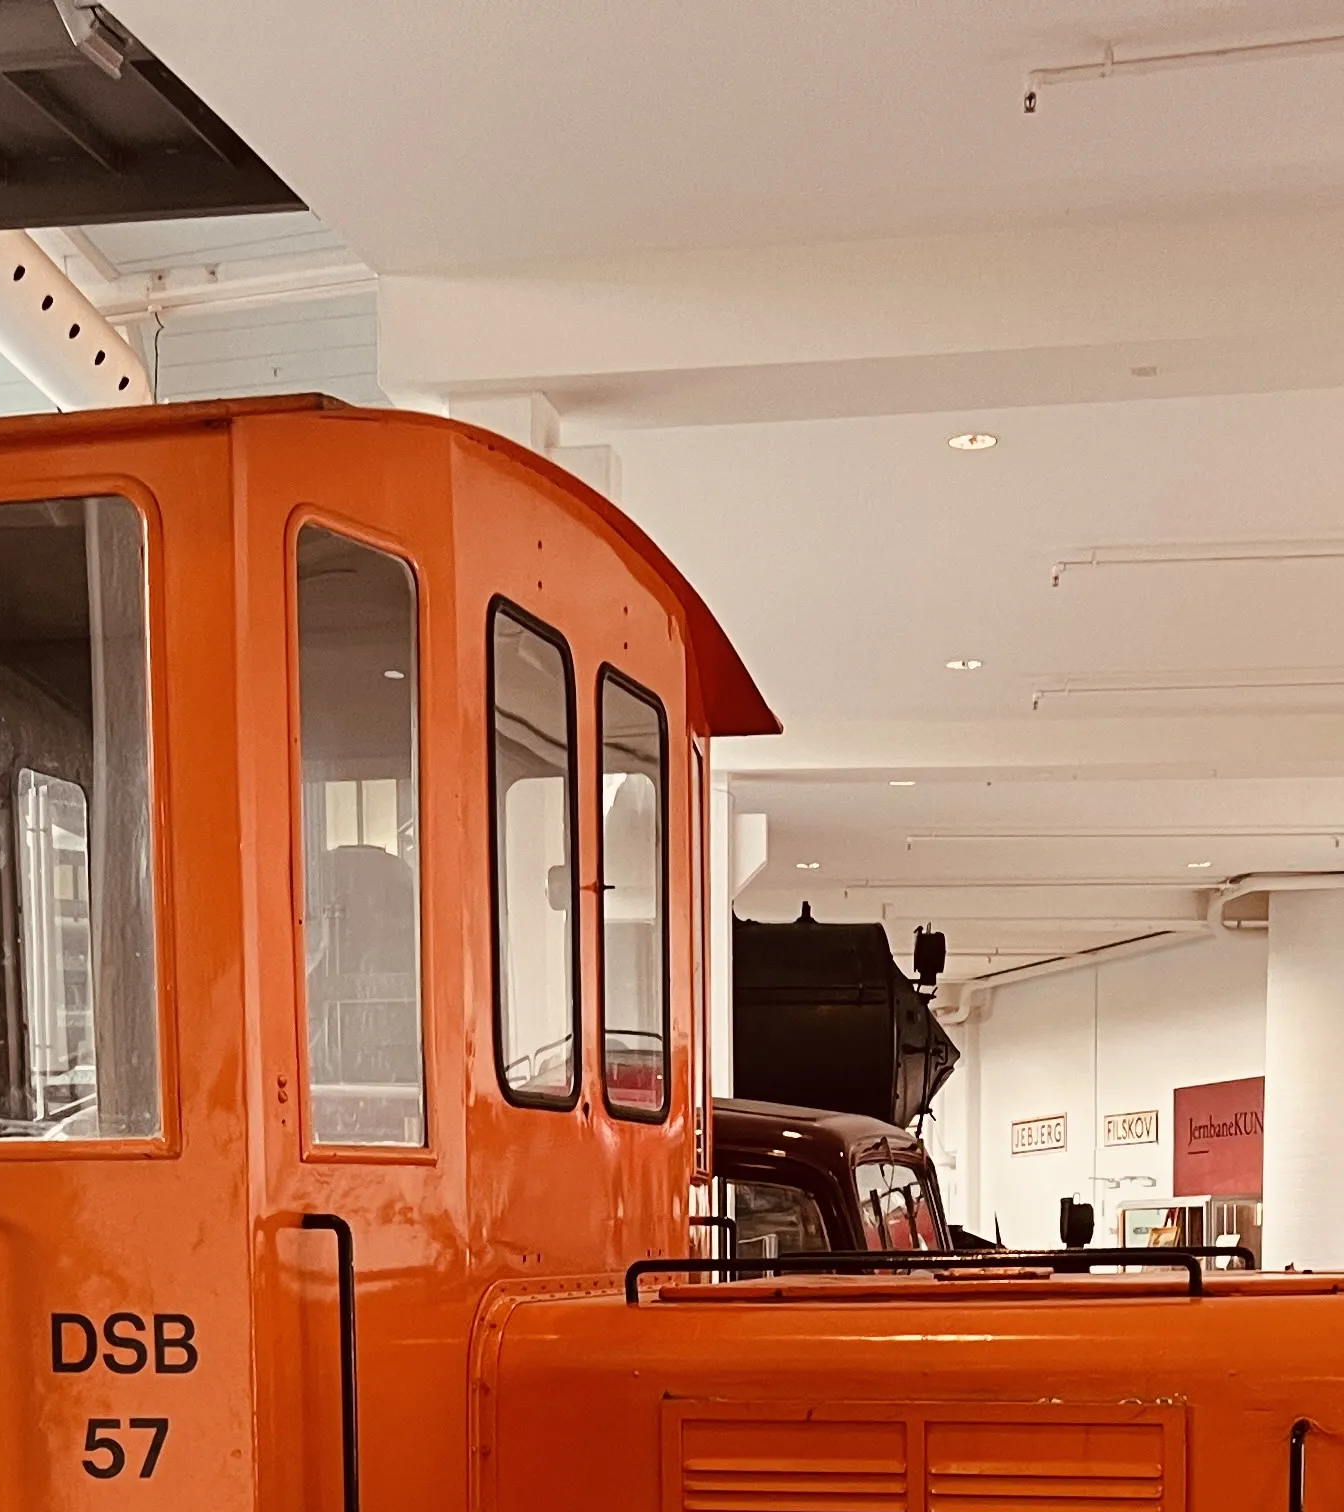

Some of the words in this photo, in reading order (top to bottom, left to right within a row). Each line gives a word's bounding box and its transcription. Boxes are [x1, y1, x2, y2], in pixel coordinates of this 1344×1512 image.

[1015, 1121, 1063, 1148] JEBJERG
[1107, 1115, 1153, 1141] FILSKOV
[51, 1312, 198, 1374] DSB
[82, 1418, 169, 1479] 57
